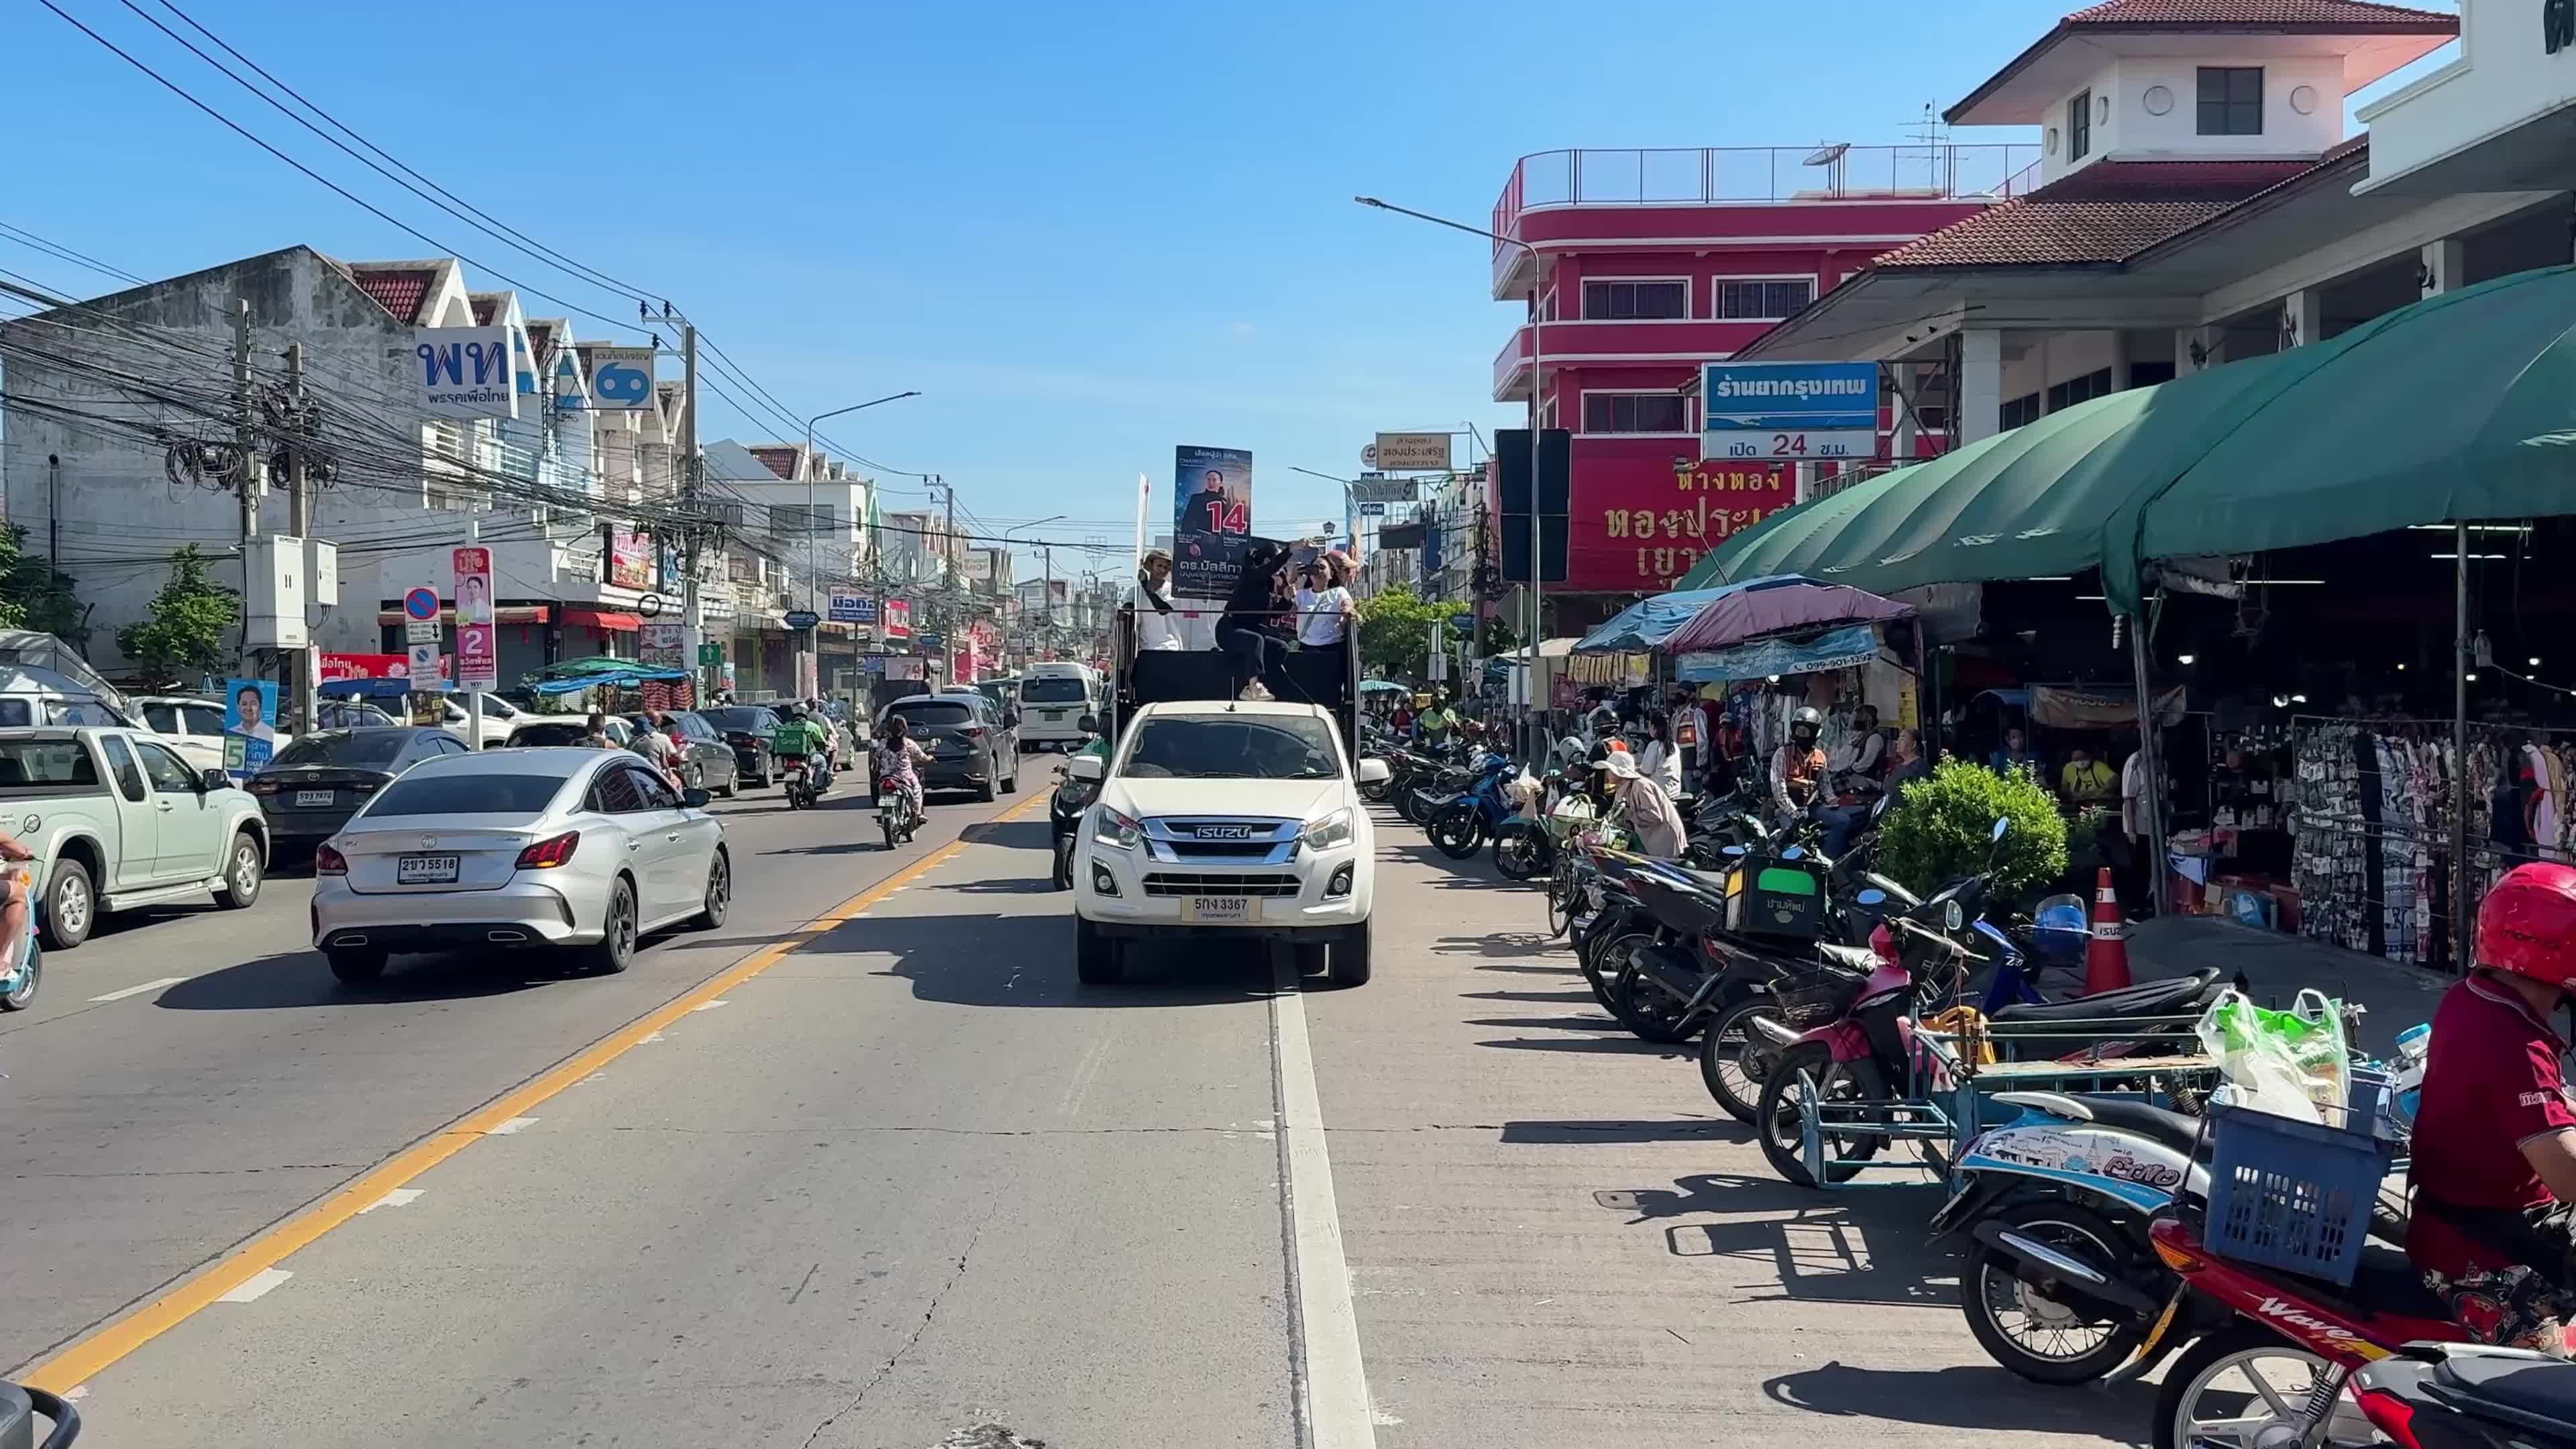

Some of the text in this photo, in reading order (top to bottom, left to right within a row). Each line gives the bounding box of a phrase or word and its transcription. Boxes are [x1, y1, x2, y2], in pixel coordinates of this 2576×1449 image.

[417, 341, 508, 386] พท
[428, 387, 510, 403] พรรคเพื่อไทย
[1717, 374, 1867, 400] ร้านยากรุงเทพ
[1729, 441, 1756, 457] เปิด
[1772, 433, 1807, 456] 24
[1677, 461, 1780, 491] ห้างทอง
[1206, 500, 1247, 534] 14
[1604, 496, 1790, 539] ทองประเ
[1638, 546, 1709, 576] เยา
[465, 629, 483, 654] 2
[321, 657, 352, 669] พื่อไทย
[1806, 653, 1873, 670] 099-901-1292
[780, 738, 800, 746] Grab
[227, 745, 244, 769] 5
[1197, 826, 1252, 838] ISUZU
[428, 859, 455, 870] 5518
[1195, 898, 1247, 910] 5กง 3367
[2100, 926, 2121, 935] ISUZ
[2259, 1297, 2365, 1342] Wave
